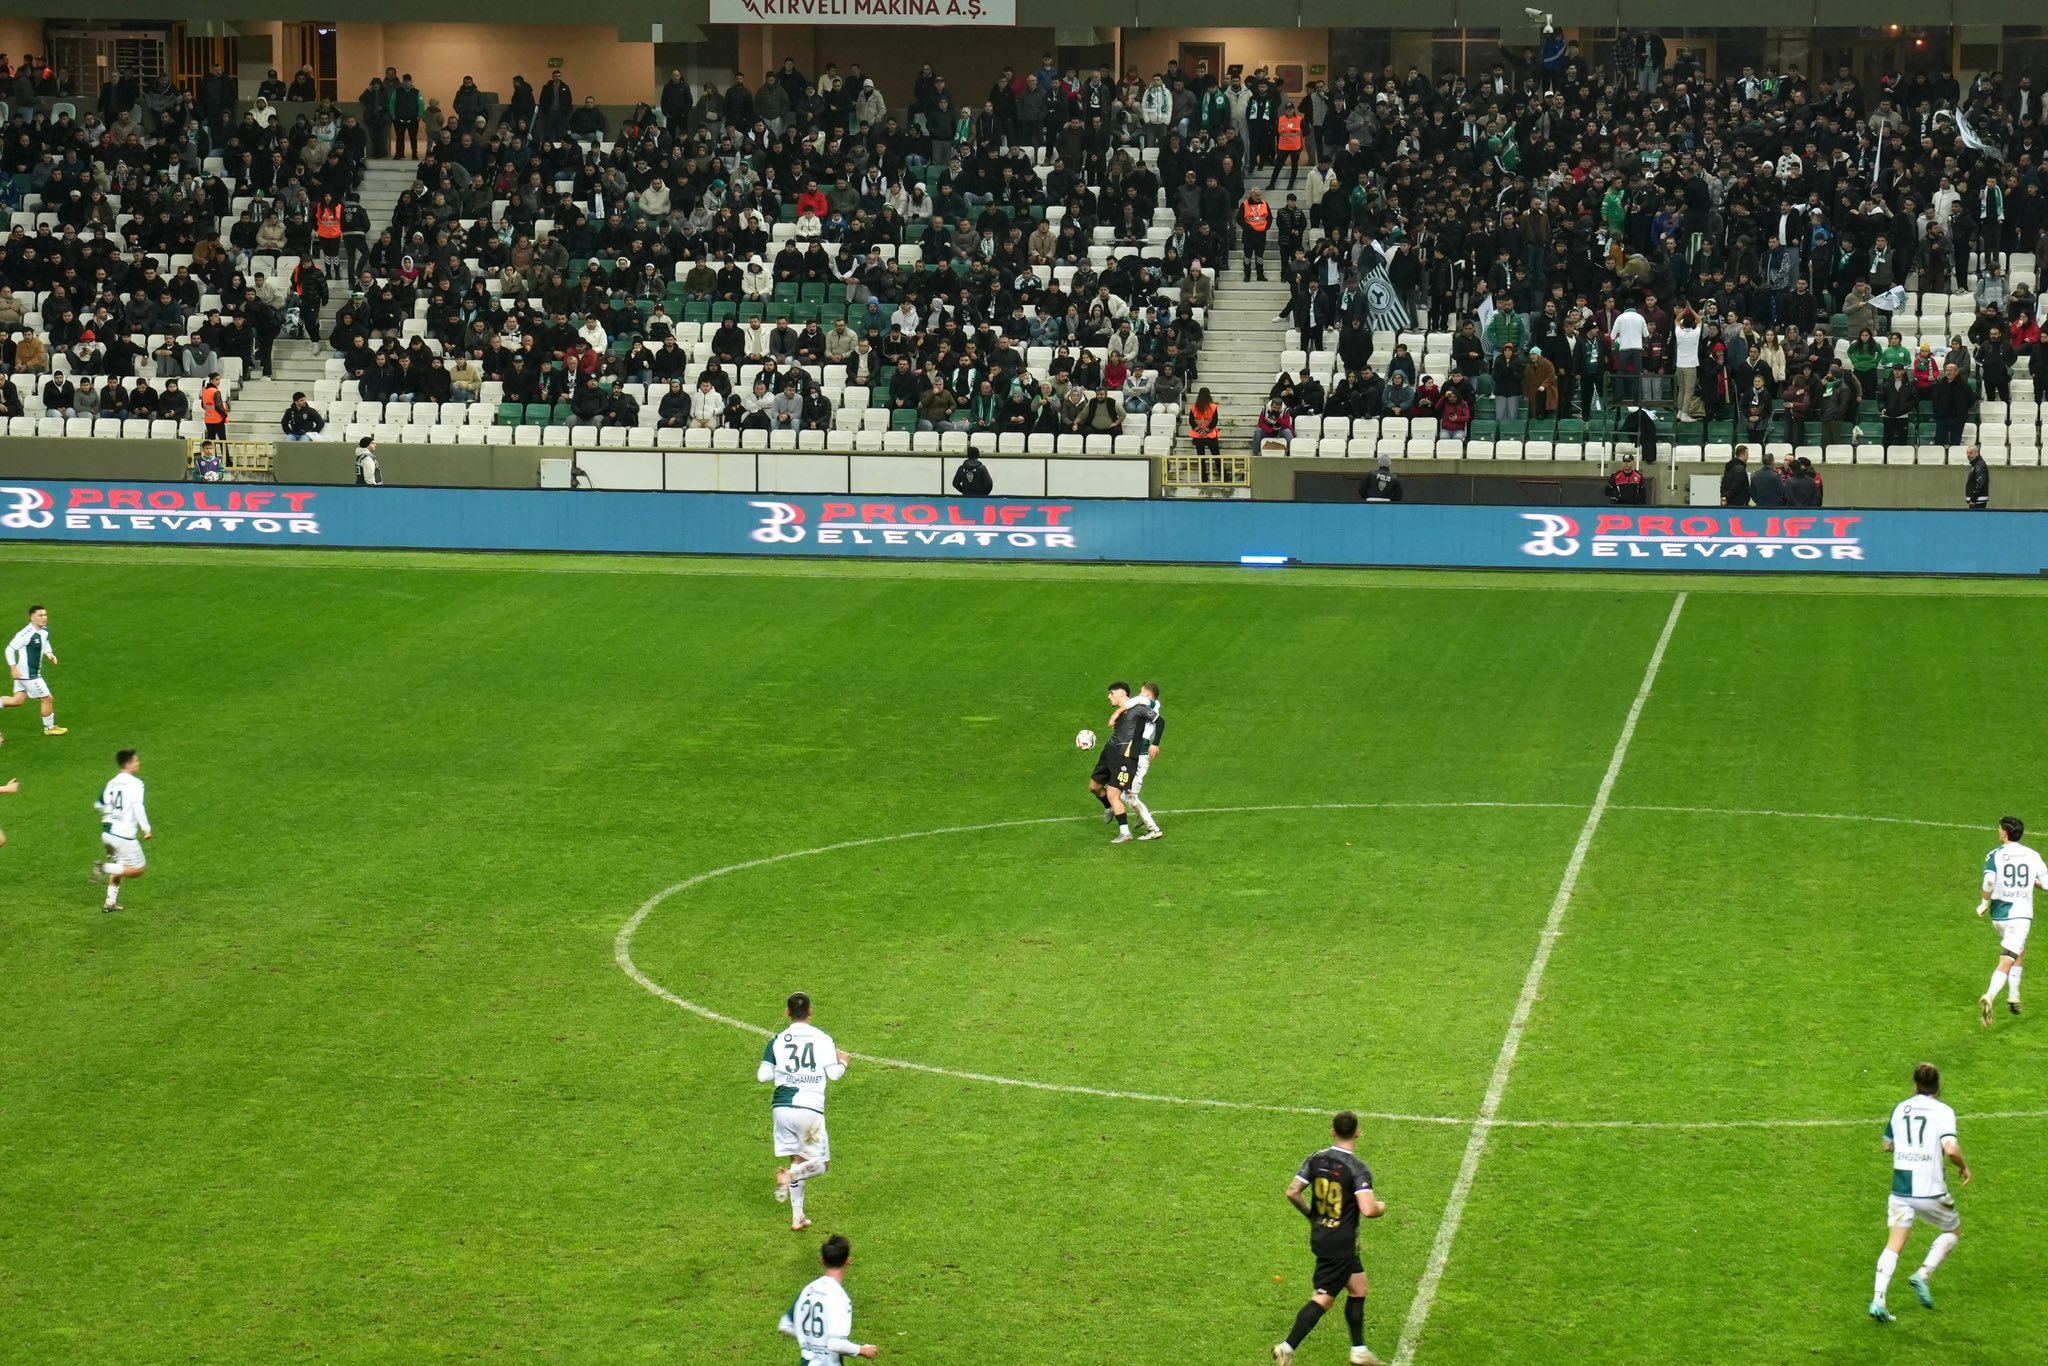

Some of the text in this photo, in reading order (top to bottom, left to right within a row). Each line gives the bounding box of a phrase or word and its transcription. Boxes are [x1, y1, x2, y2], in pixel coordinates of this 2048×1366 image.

[67, 488, 317, 512] PROLIFT
[65, 515, 321, 534] ELEVATOR
[820, 503, 1074, 525] PROLIFT
[1594, 514, 1862, 538] PROLIFT
[817, 529, 1078, 548] ELEVATOR
[1591, 541, 1866, 560] ELEVATOR
[1117, 771, 1129, 783] 49
[2003, 863, 2029, 888] 99
[784, 1042, 817, 1073] 34
[1902, 1115, 1927, 1146] 17
[801, 1299, 824, 1338] 26
